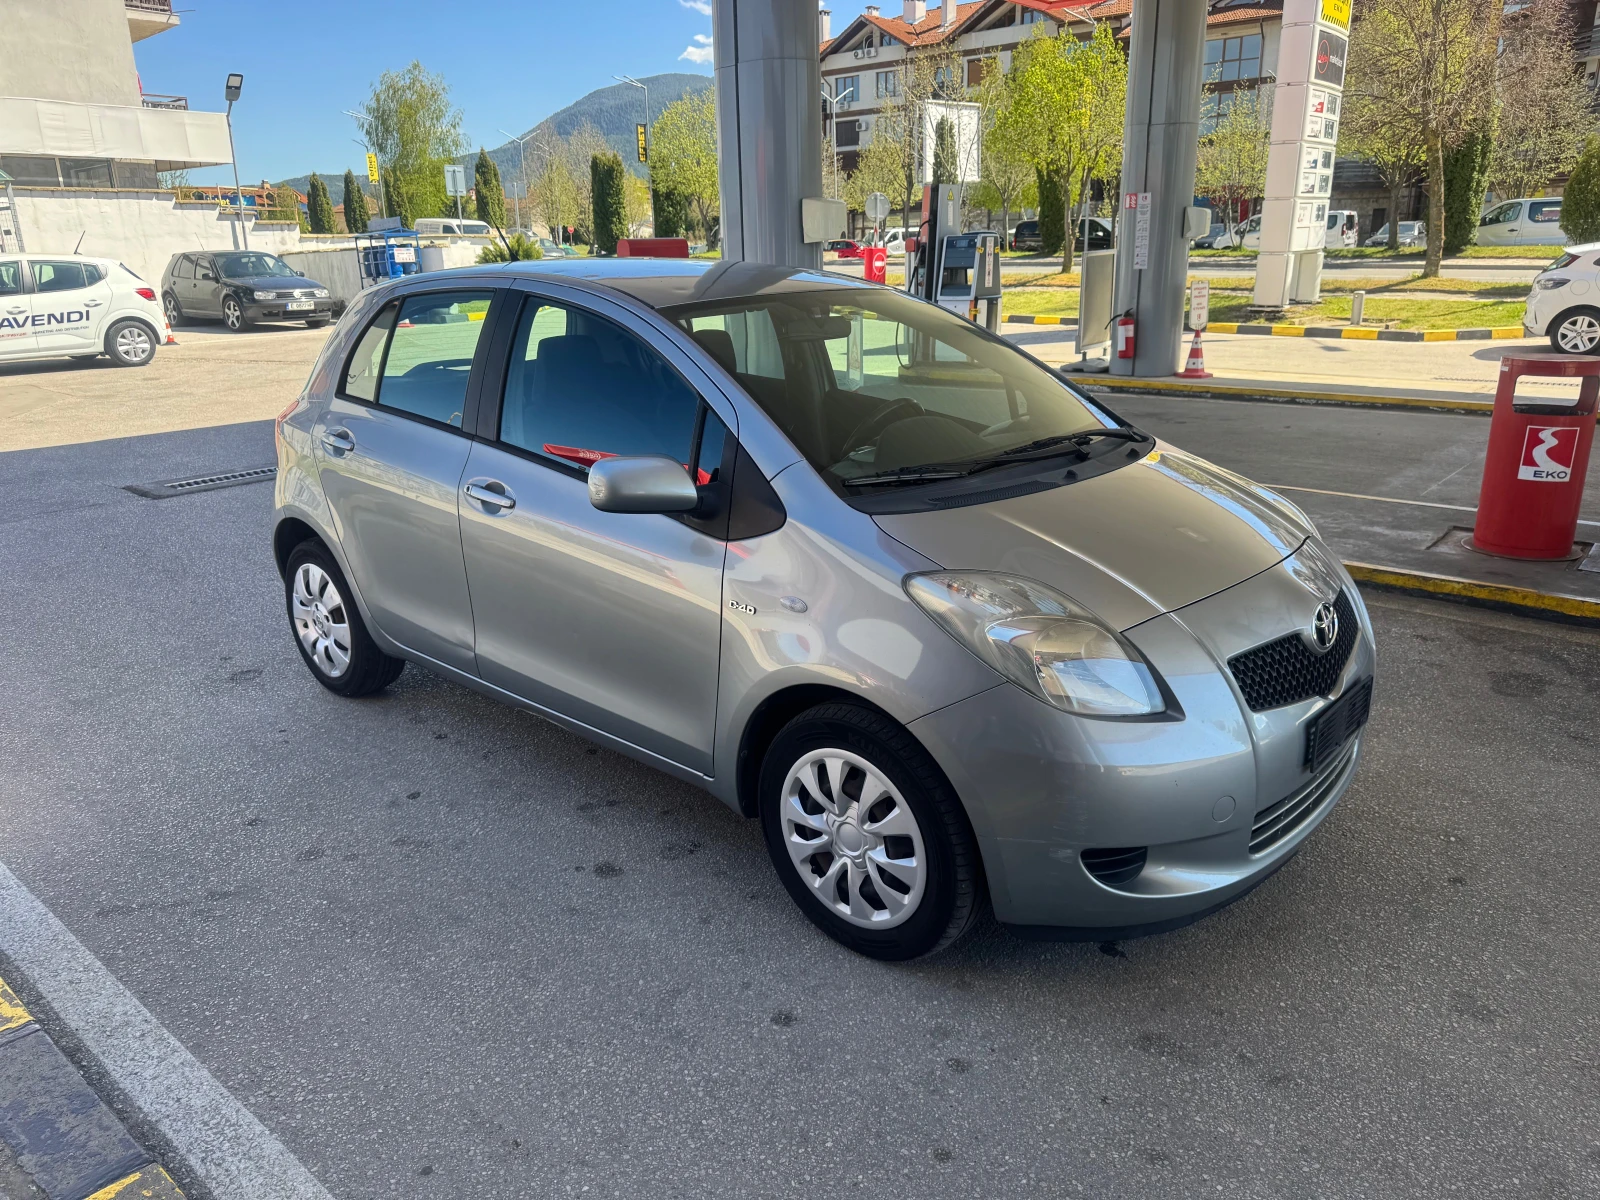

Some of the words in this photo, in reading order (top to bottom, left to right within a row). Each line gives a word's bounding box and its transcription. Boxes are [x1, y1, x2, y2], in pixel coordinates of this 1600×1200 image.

[637, 125, 646, 162] EFBET
[0, 310, 90, 330] AVENDI
[1533, 470, 1568, 480] EKO
